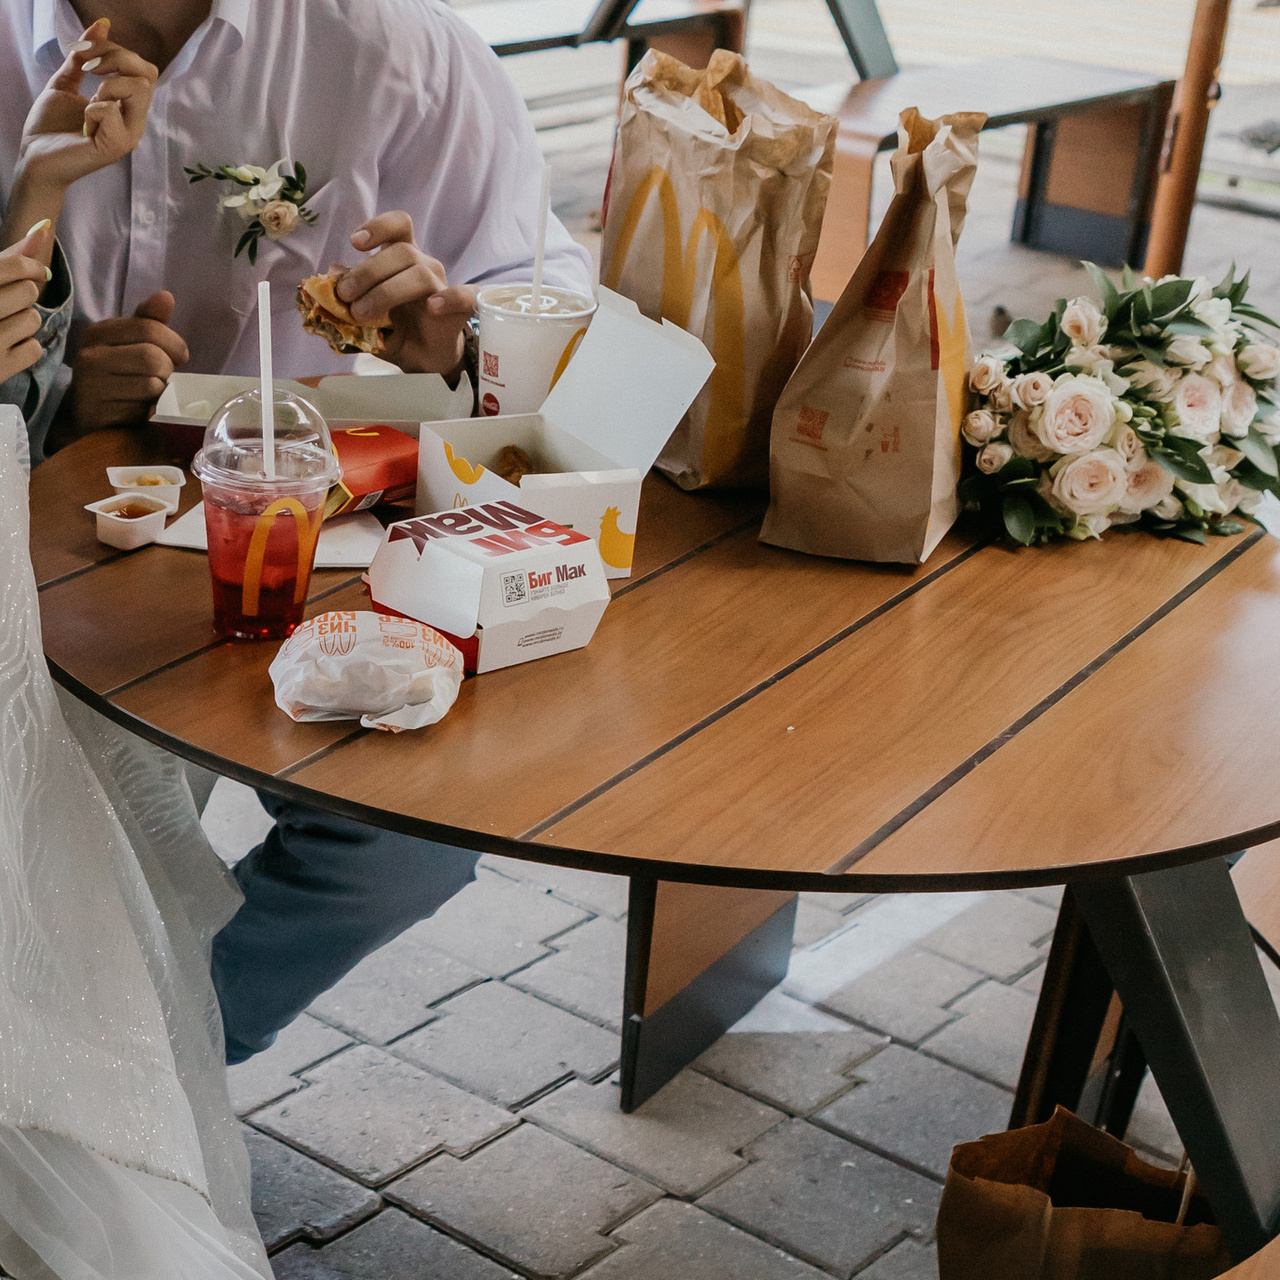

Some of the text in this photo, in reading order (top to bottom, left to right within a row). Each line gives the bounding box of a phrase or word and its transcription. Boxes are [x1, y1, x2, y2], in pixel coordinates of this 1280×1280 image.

[527, 571, 553, 590] Биг
[554, 563, 587, 583] Мак
[318, 621, 357, 635] ЧИЗ
